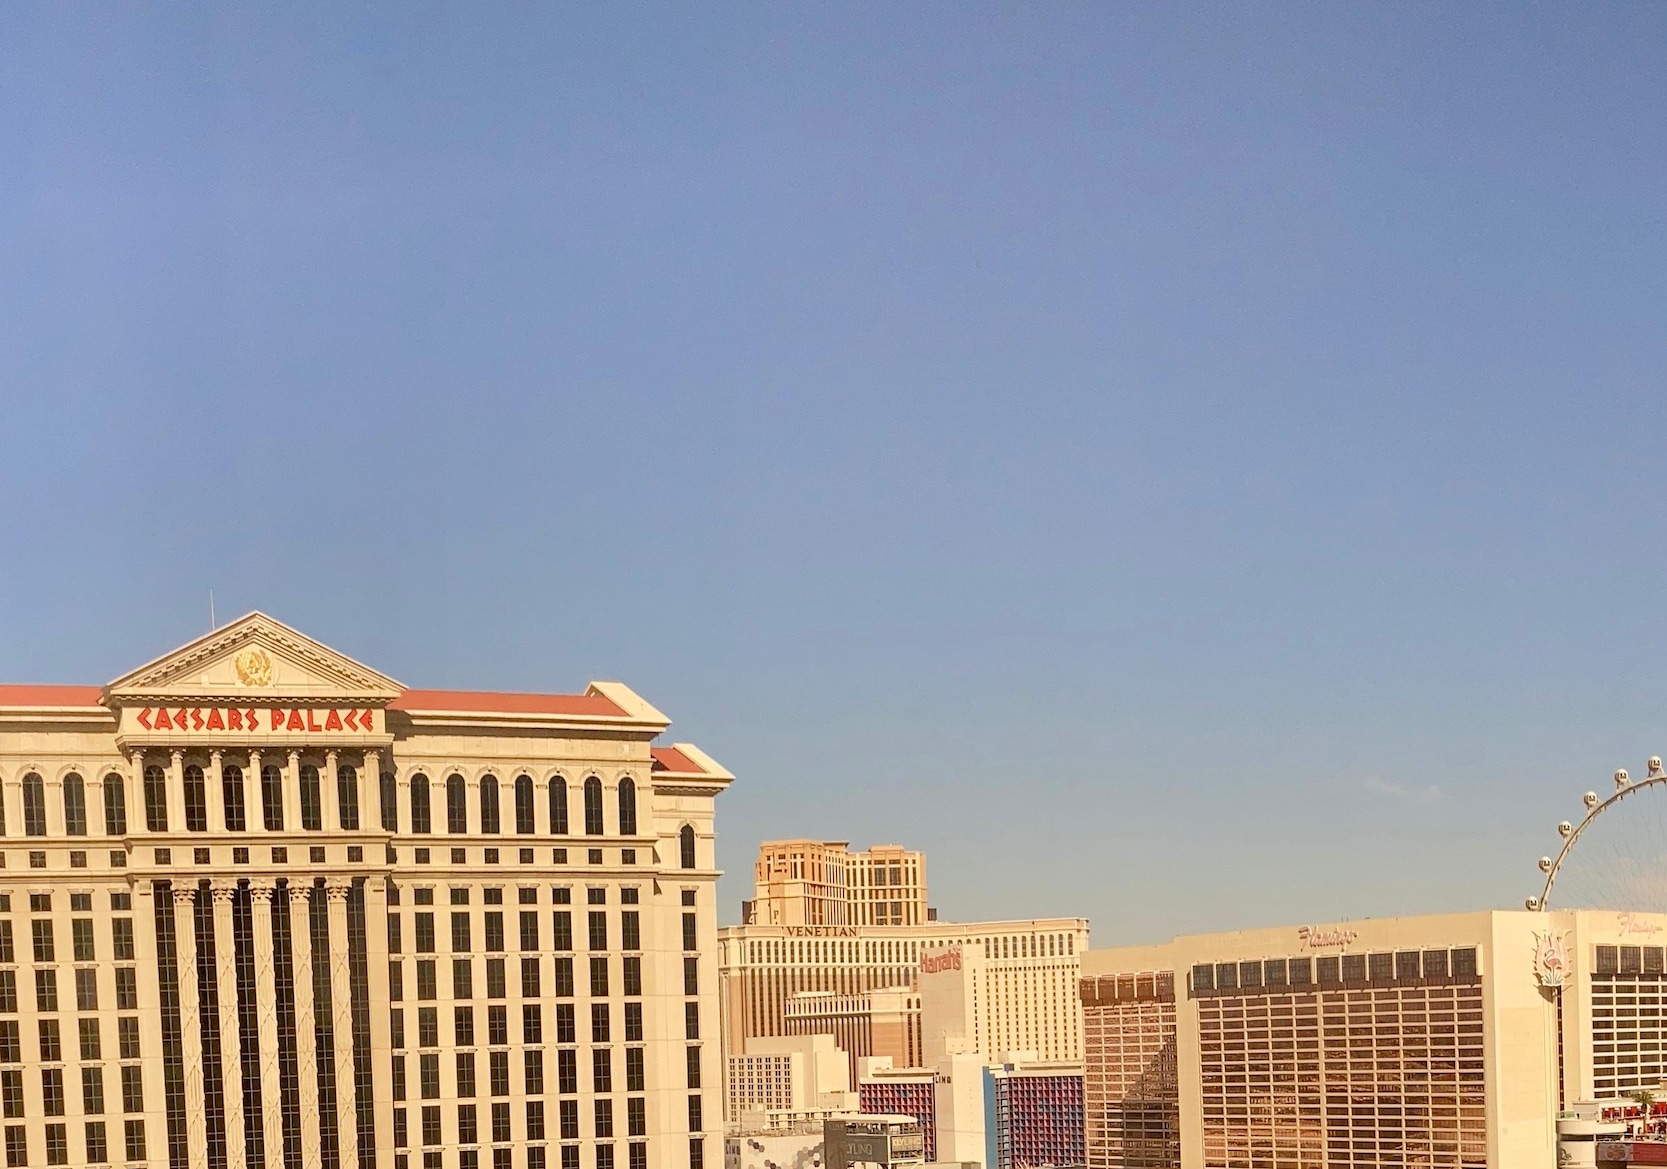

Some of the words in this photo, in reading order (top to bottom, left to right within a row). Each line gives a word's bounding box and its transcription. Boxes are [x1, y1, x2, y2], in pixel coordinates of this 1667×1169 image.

[137, 707, 259, 732] CAESARS
[271, 708, 373, 732] PALACE
[786, 926, 858, 938] VENETIAN
[1617, 912, 1662, 936] Flamingo
[1298, 924, 1359, 952] Flamingo
[920, 950, 962, 974] Harrah's
[935, 1075, 952, 1084] LINQ
